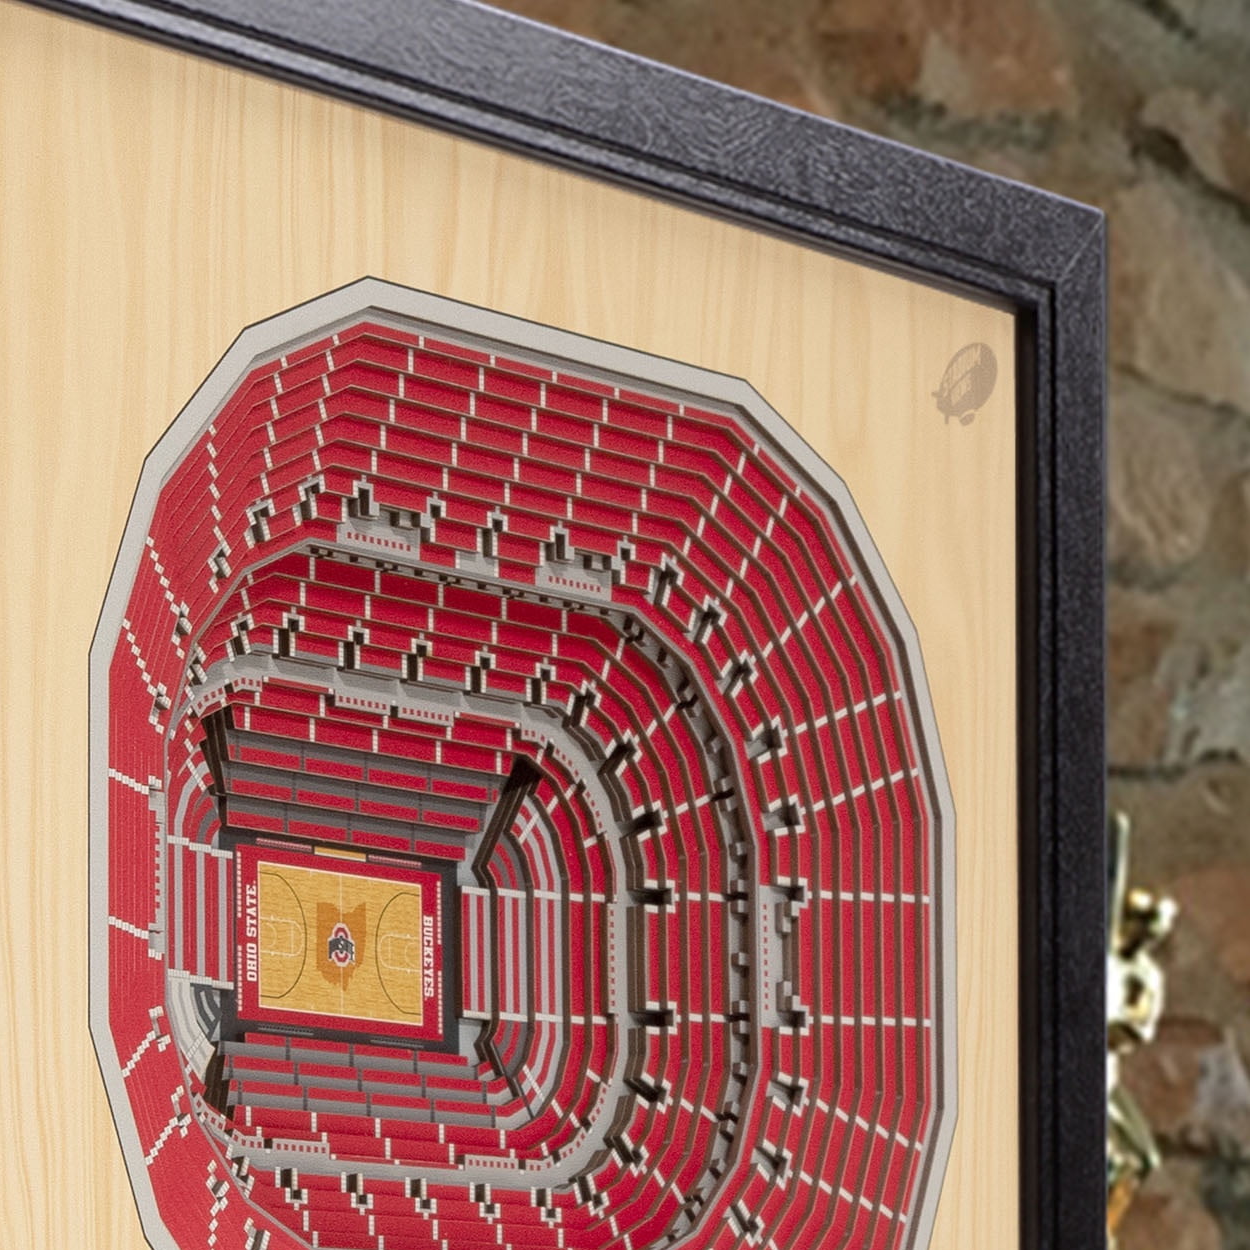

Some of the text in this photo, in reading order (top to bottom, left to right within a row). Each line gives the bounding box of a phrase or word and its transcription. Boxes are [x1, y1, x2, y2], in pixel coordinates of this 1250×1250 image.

[246, 884, 257, 982] OHIO STATE
[423, 915, 434, 998] BUCKEYES
